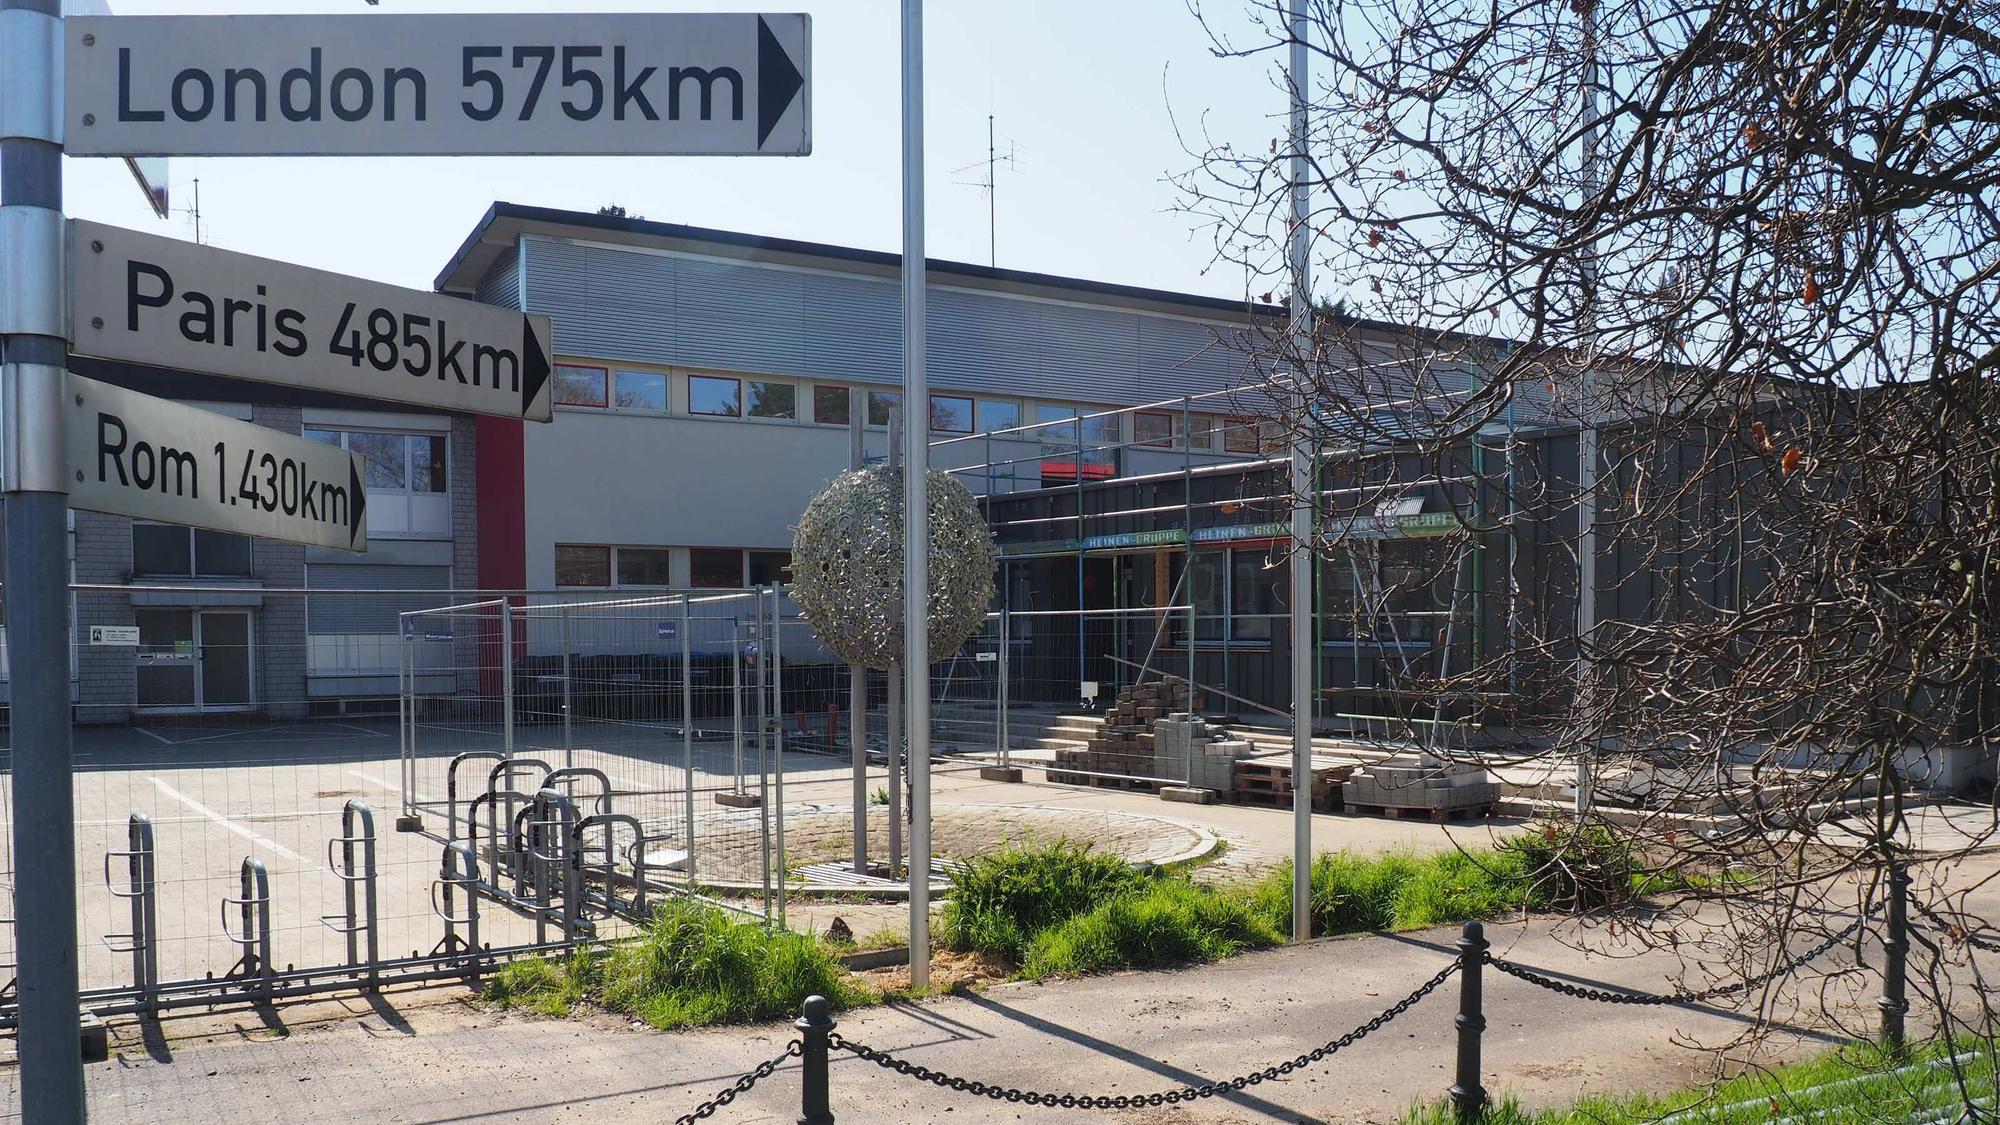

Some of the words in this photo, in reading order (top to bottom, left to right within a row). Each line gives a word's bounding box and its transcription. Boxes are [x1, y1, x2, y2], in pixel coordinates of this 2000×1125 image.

[118, 47, 427, 122] London
[461, 45, 744, 122] 575km
[127, 260, 308, 358] Paris
[328, 302, 520, 394] 485km
[97, 412, 198, 499] Rom
[214, 441, 349, 527] 1.430km
[1089, 531, 1179, 547] HEINEN-GRUPPE
